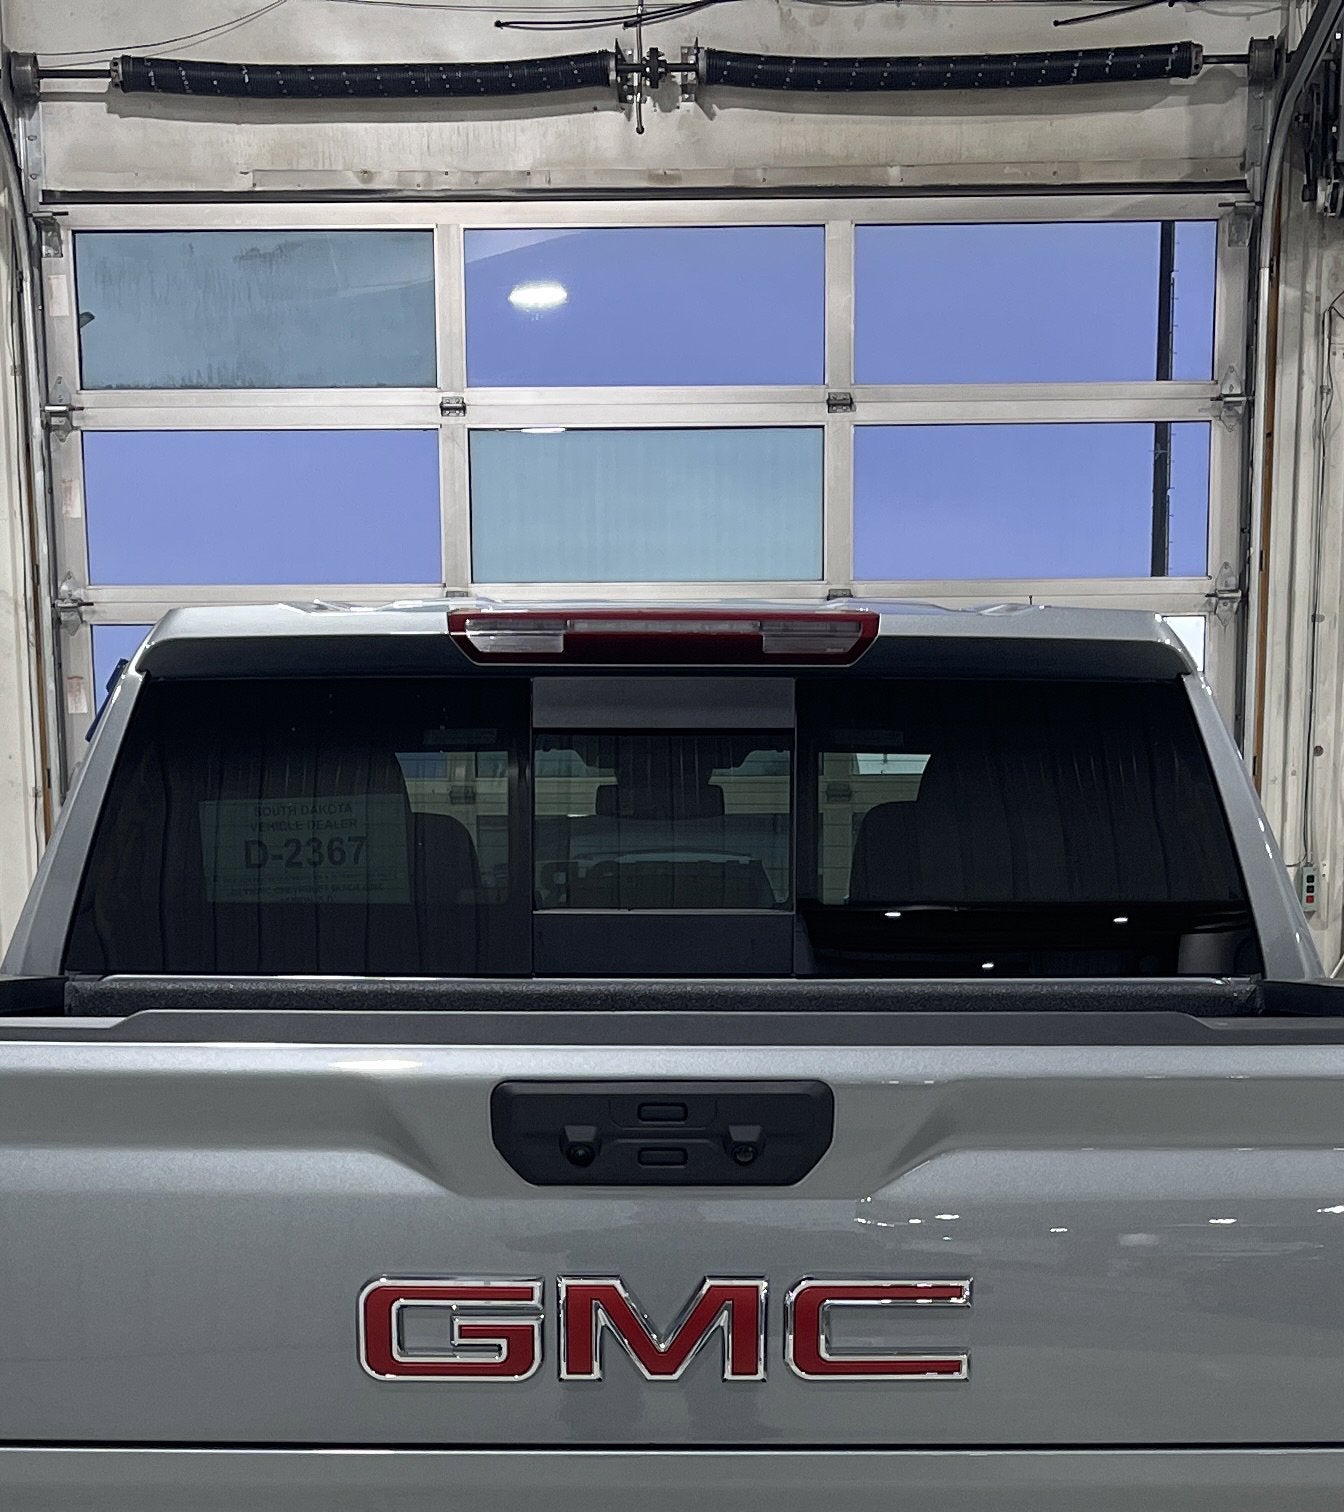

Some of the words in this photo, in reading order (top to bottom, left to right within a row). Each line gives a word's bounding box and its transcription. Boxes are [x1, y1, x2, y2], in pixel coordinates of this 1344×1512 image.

[301, 803, 352, 815] DAKOTA
[250, 820, 304, 832] VEHICLE
[307, 819, 357, 830] DEALER
[244, 835, 369, 869] D-2367
[356, 1273, 974, 1383] GMC
